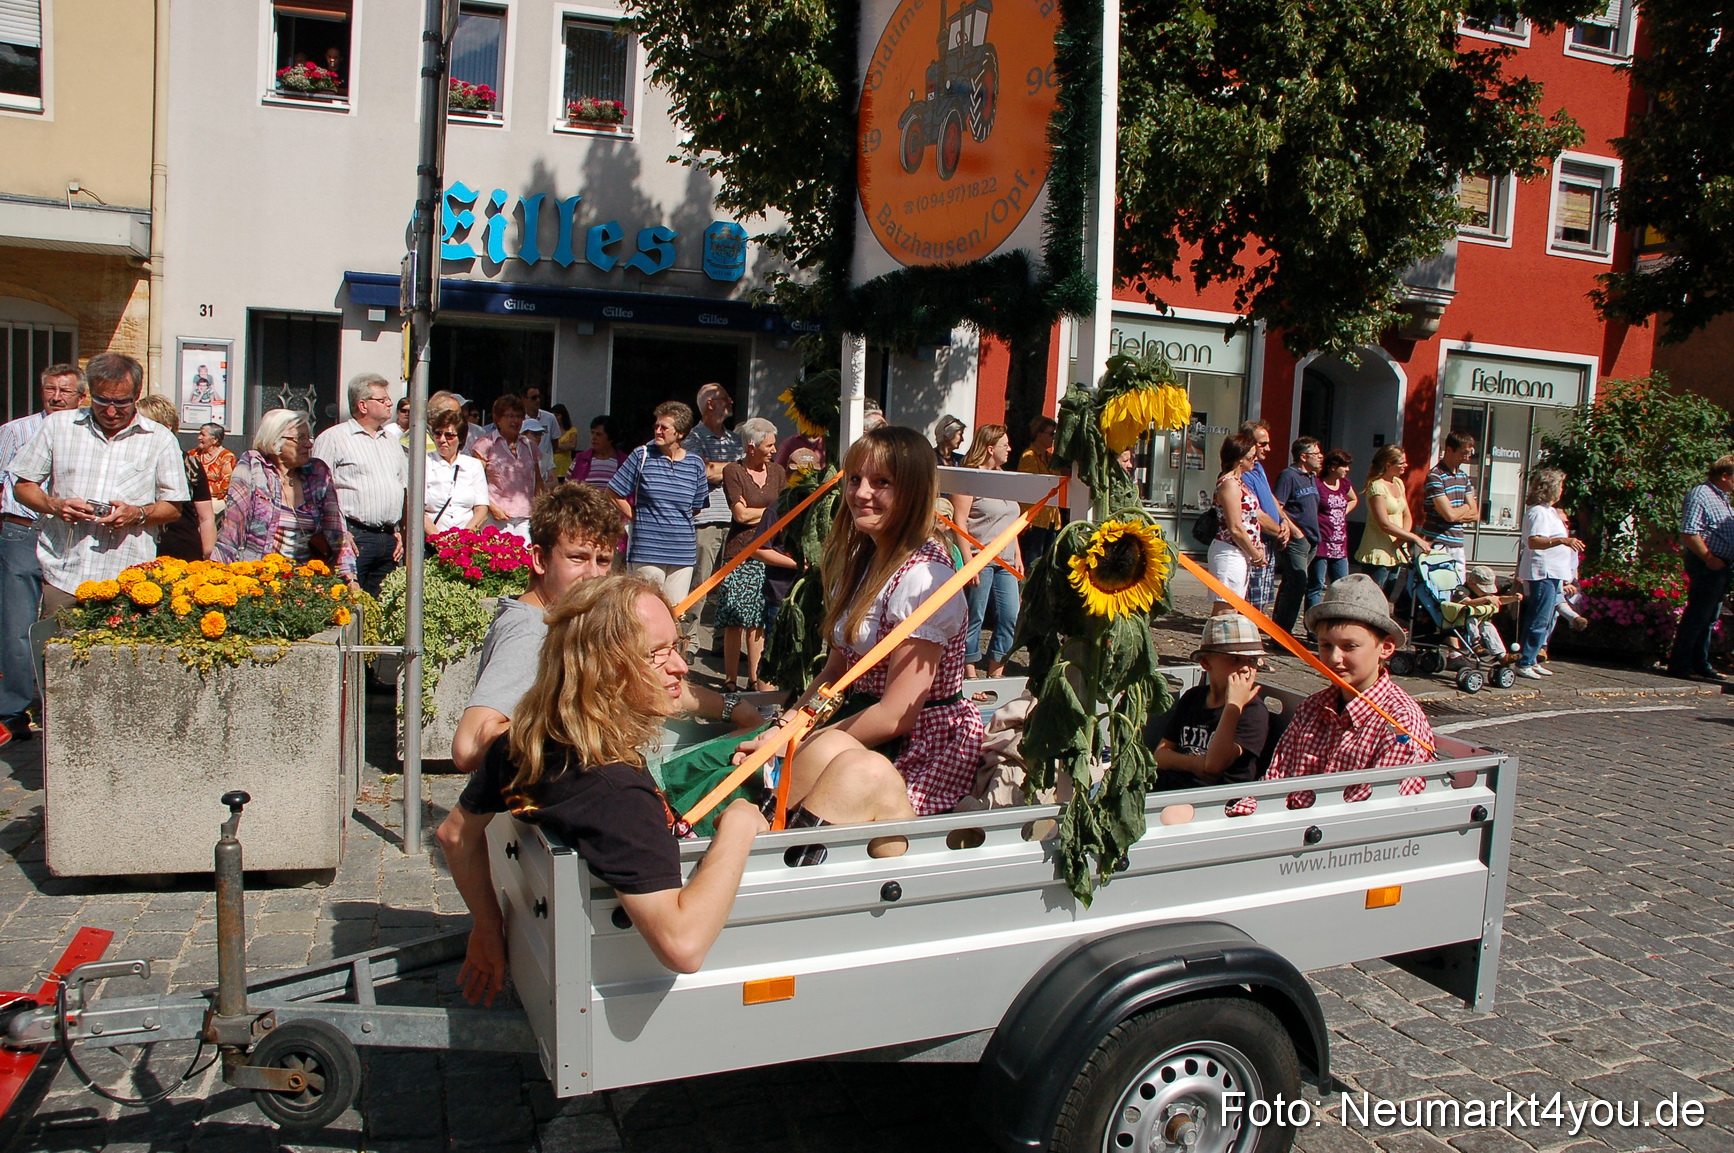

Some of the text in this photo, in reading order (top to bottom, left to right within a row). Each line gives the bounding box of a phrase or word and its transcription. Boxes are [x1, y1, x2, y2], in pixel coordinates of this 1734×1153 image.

[1026, 61, 1057, 96] 96
[414, 181, 679, 275] Eilles
[199, 304, 213, 318] 31
[503, 298, 536, 312] Eilles
[602, 306, 634, 319] Eilles
[698, 313, 729, 326] Eilles
[1279, 839, 1420, 876] www.humbaur.de
